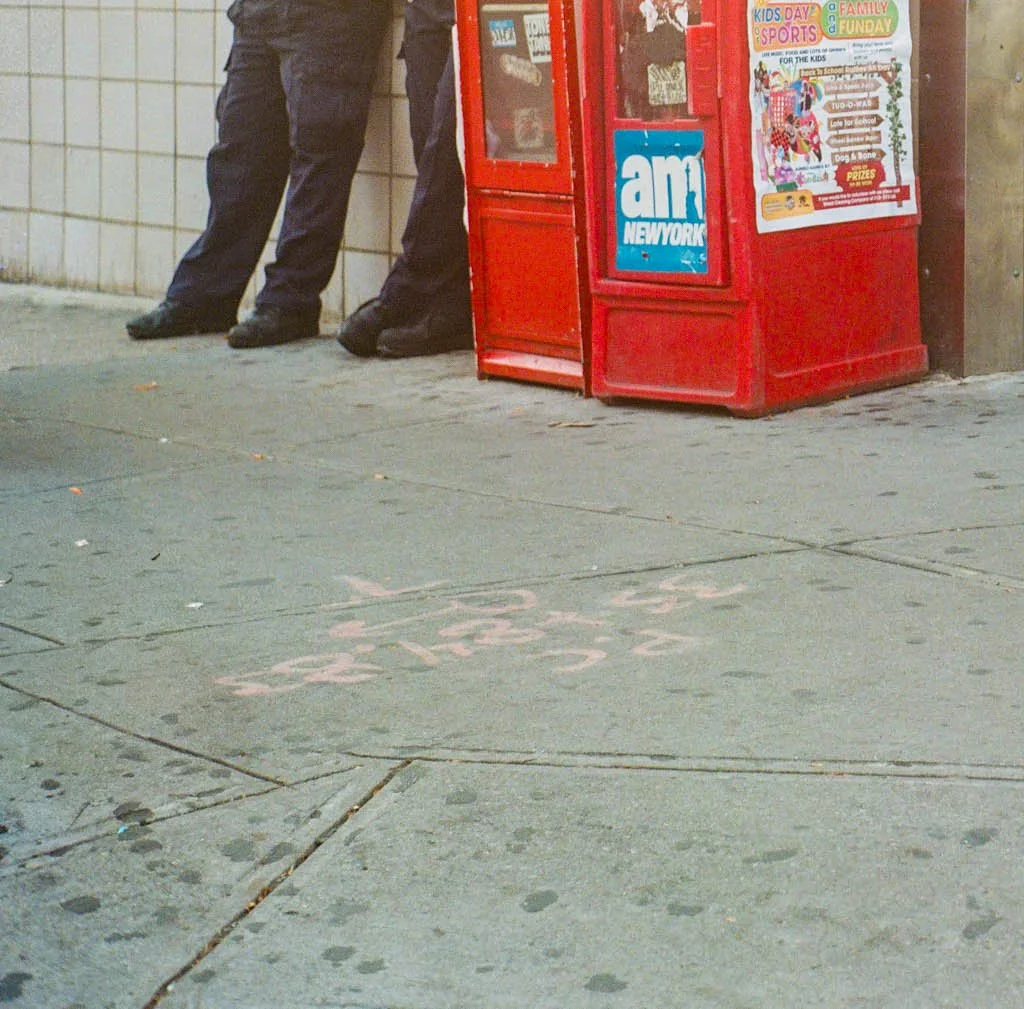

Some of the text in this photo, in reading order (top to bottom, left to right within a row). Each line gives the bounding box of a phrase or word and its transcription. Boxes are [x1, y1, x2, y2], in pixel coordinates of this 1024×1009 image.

[754, 5, 809, 23] KIDS DAY
[839, 0, 889, 16] FAMILY
[828, 2, 836, 34] and
[839, 19, 892, 34] FUNDAY
[761, 24, 817, 46] SPORTS
[810, 54, 827, 62] KIDS
[831, 101, 872, 110] TUG-O-WAR
[831, 119, 843, 127] Late
[854, 117, 876, 125] School
[835, 154, 850, 162] Dog
[846, 169, 876, 181] PRIZES
